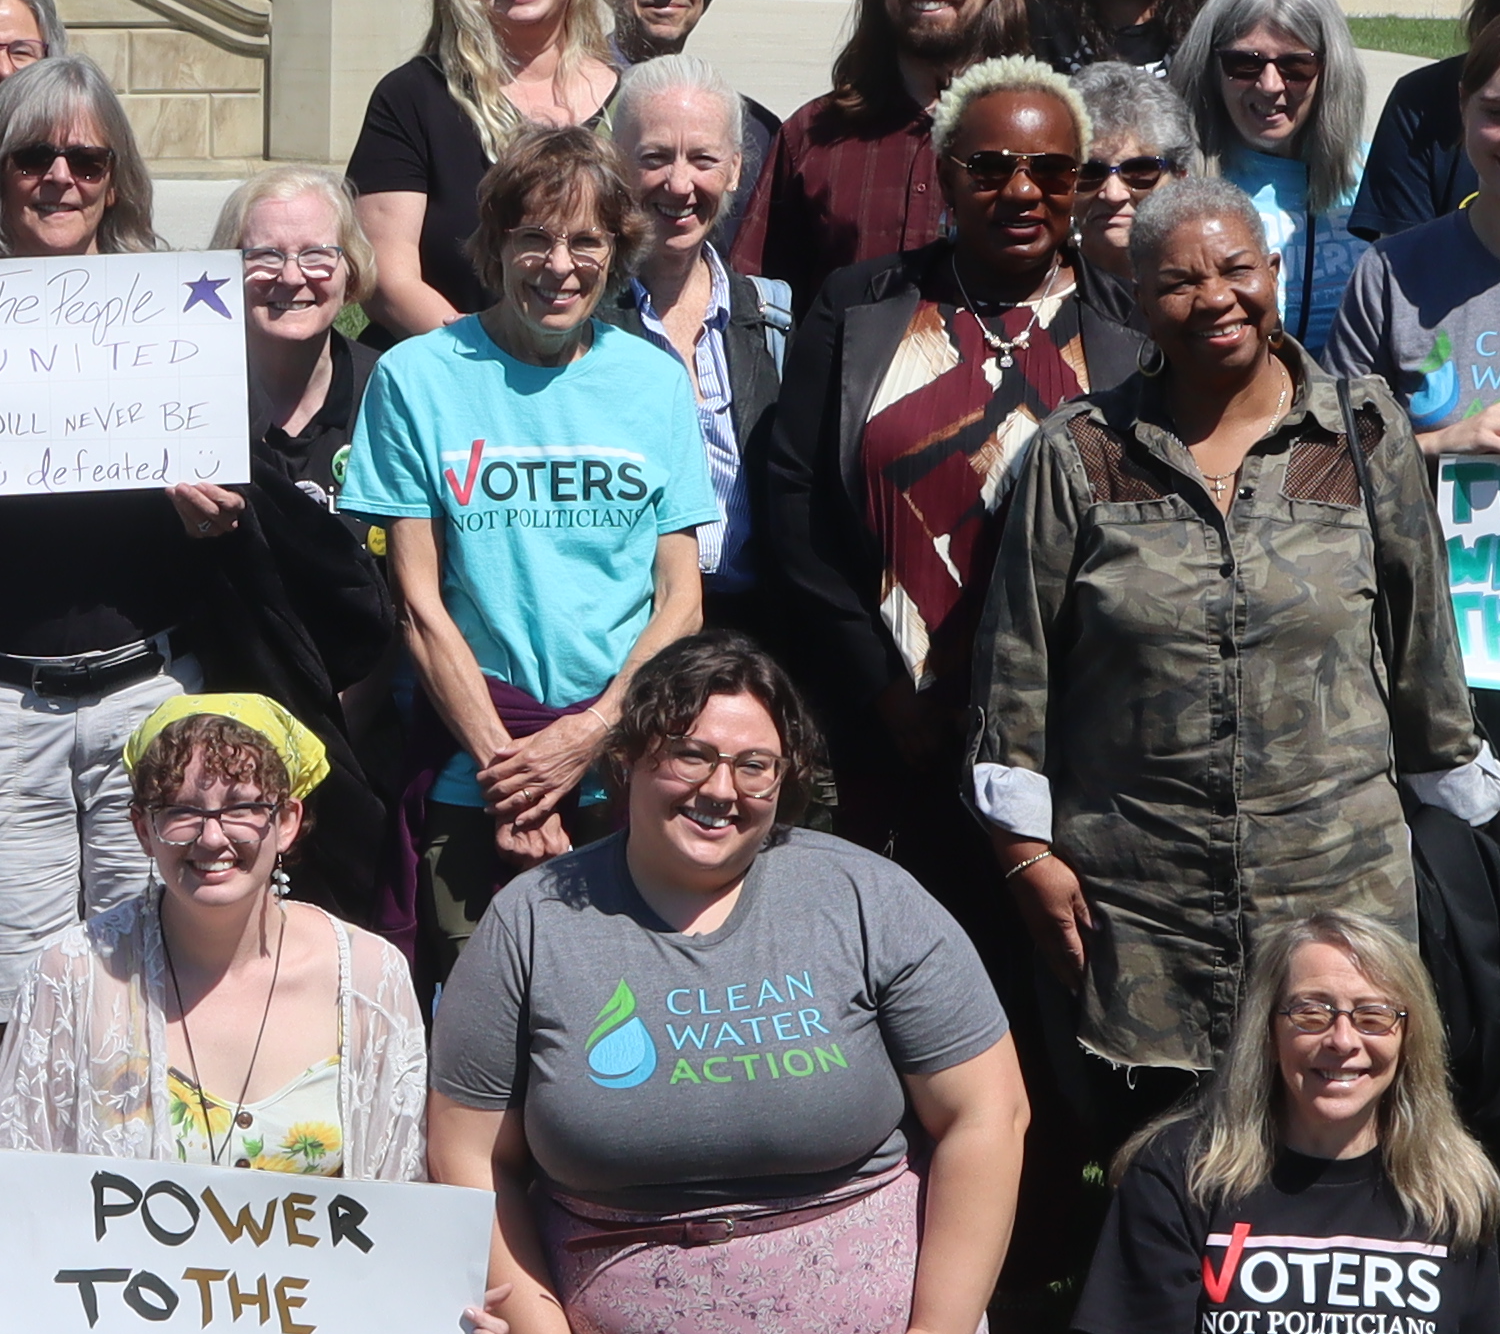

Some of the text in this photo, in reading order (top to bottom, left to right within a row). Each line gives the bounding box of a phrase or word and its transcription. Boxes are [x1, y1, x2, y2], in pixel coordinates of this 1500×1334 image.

[47, 268, 165, 346] People
[65, 401, 146, 437] NEVER
[160, 402, 210, 432] BE
[27, 448, 171, 493] defeated
[444, 441, 648, 507] VOTERS
[452, 508, 644, 535] NOT POLITICIANS
[666, 970, 815, 1015] CLEAN
[665, 1008, 830, 1051] WATER
[669, 1043, 850, 1085] ACTION
[90, 1170, 375, 1255] POWER
[1202, 1225, 1442, 1313] VOTERS
[53, 1268, 179, 1329] TO
